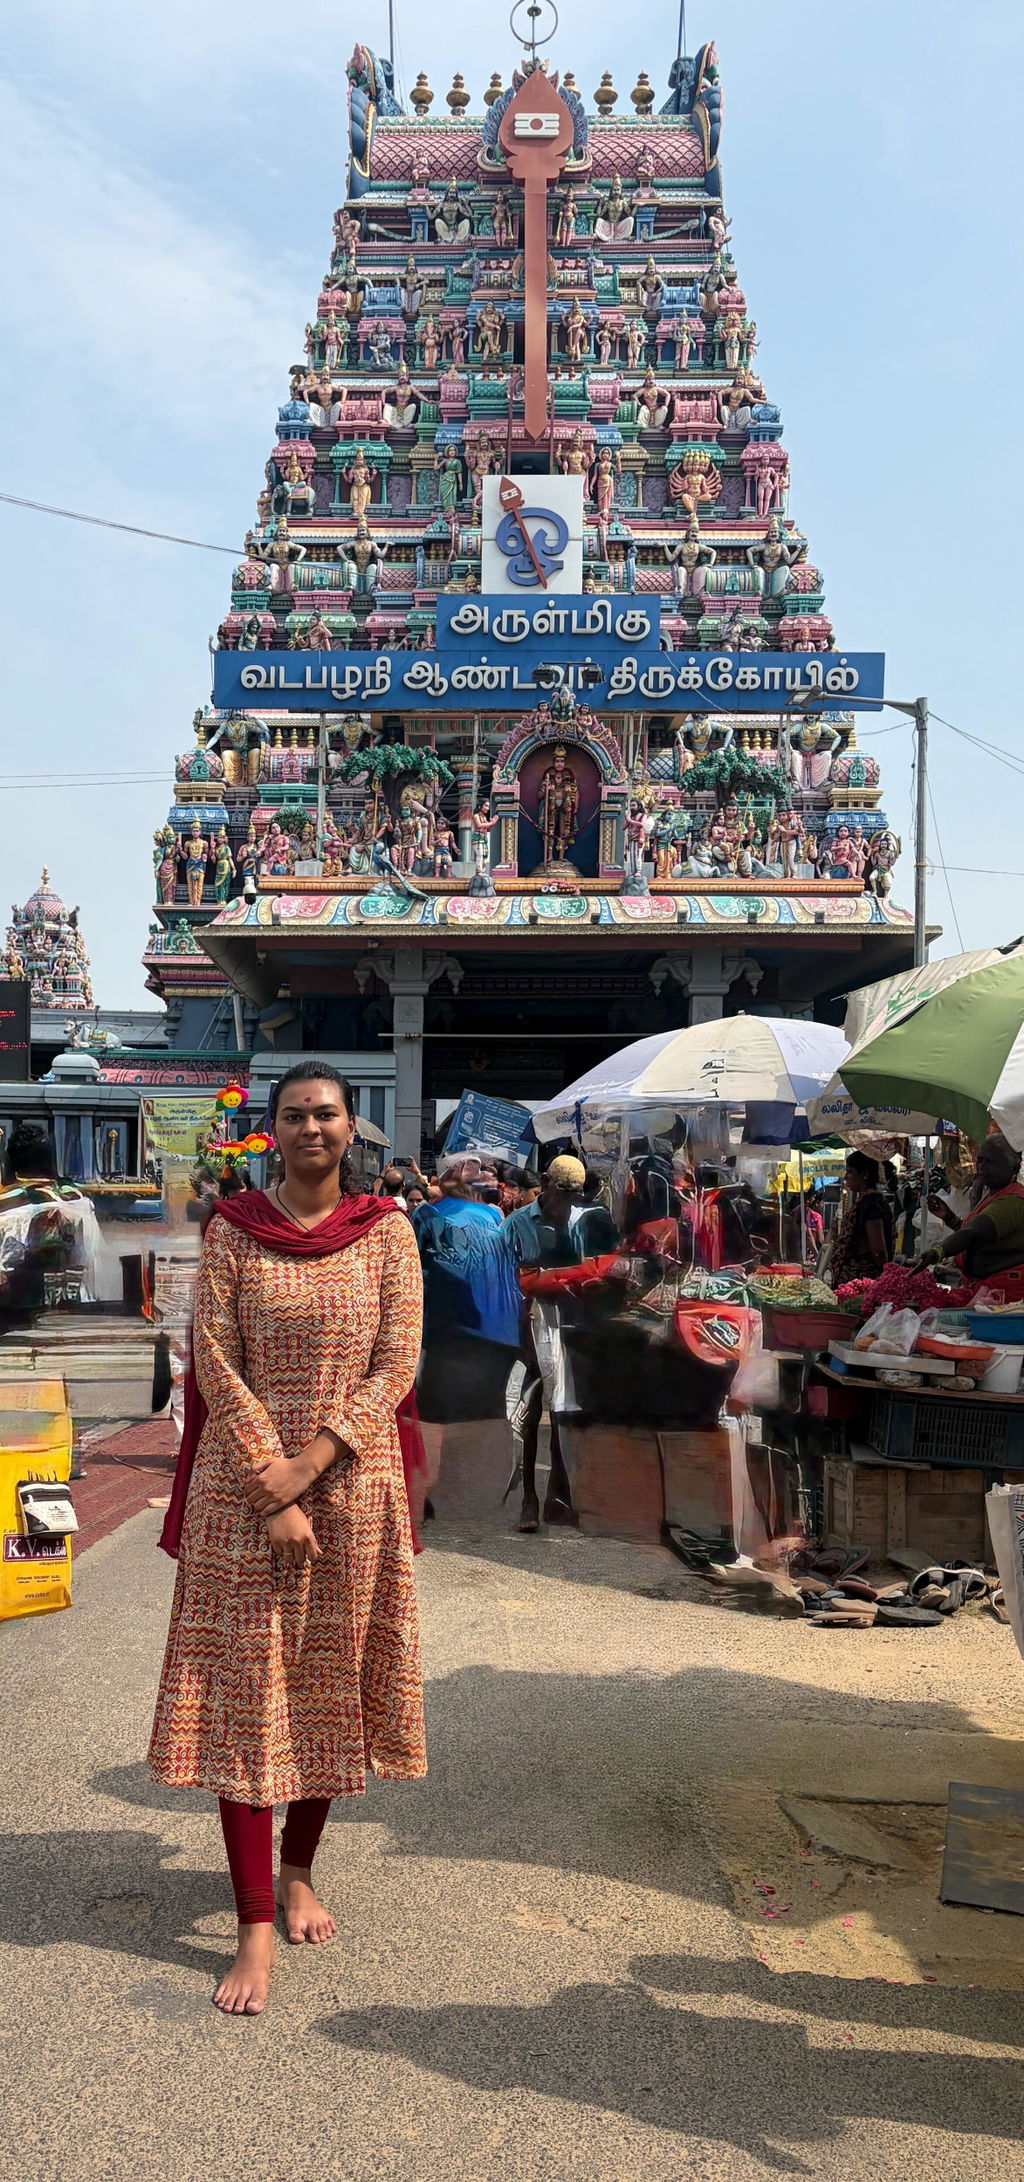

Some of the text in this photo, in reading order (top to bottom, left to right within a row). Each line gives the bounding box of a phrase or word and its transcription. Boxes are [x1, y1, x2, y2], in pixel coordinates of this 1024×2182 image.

[450, 599, 651, 643] அருள்மிகு
[240, 655, 392, 700] வடபழநி
[607, 656, 859, 700] திருக்கோயில்
[821, 1099, 853, 1115] லலிதா
